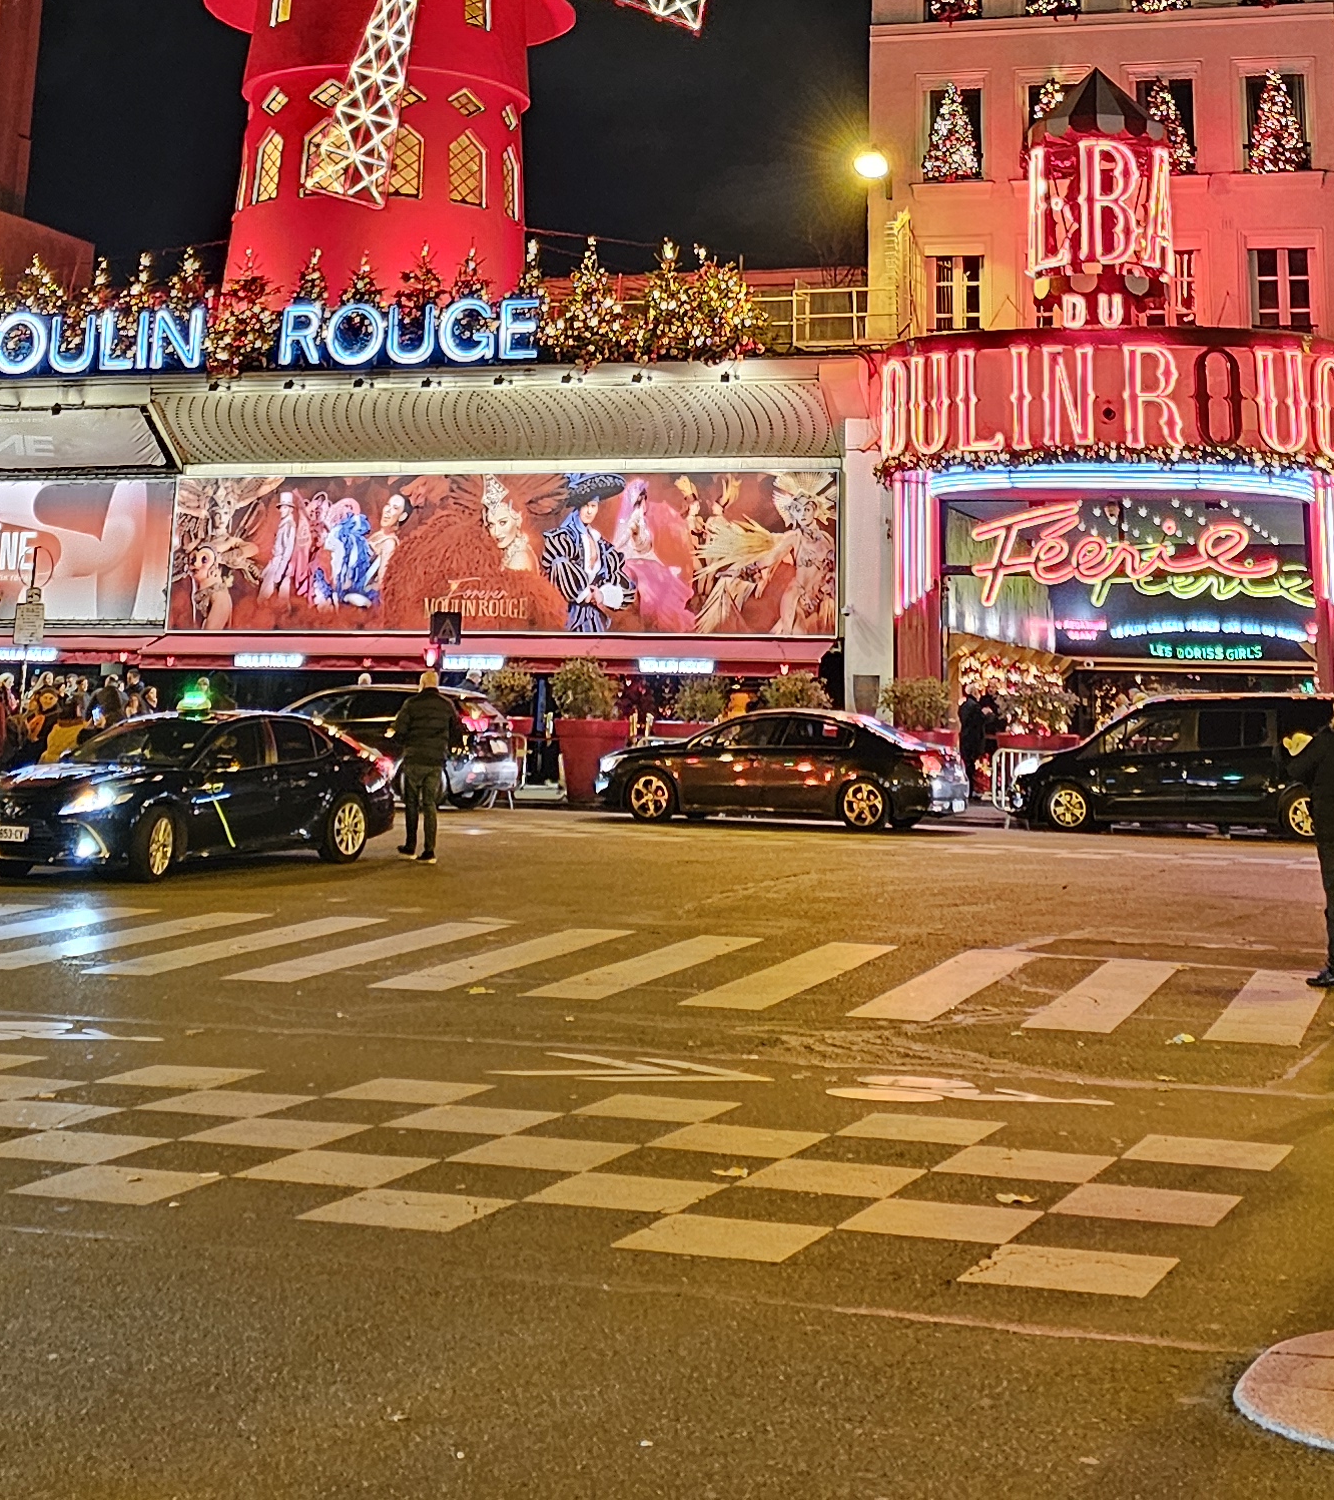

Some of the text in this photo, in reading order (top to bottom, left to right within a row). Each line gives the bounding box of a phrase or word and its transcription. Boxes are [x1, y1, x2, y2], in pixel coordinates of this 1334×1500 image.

[1062, 293, 1123, 329] DU
[278, 298, 540, 366] ROUGE
[881, 344, 1095, 457] OULIN
[442, 577, 509, 600] Forever
[477, 597, 528, 619] ROUGE
[1149, 643, 1173, 658] LES
